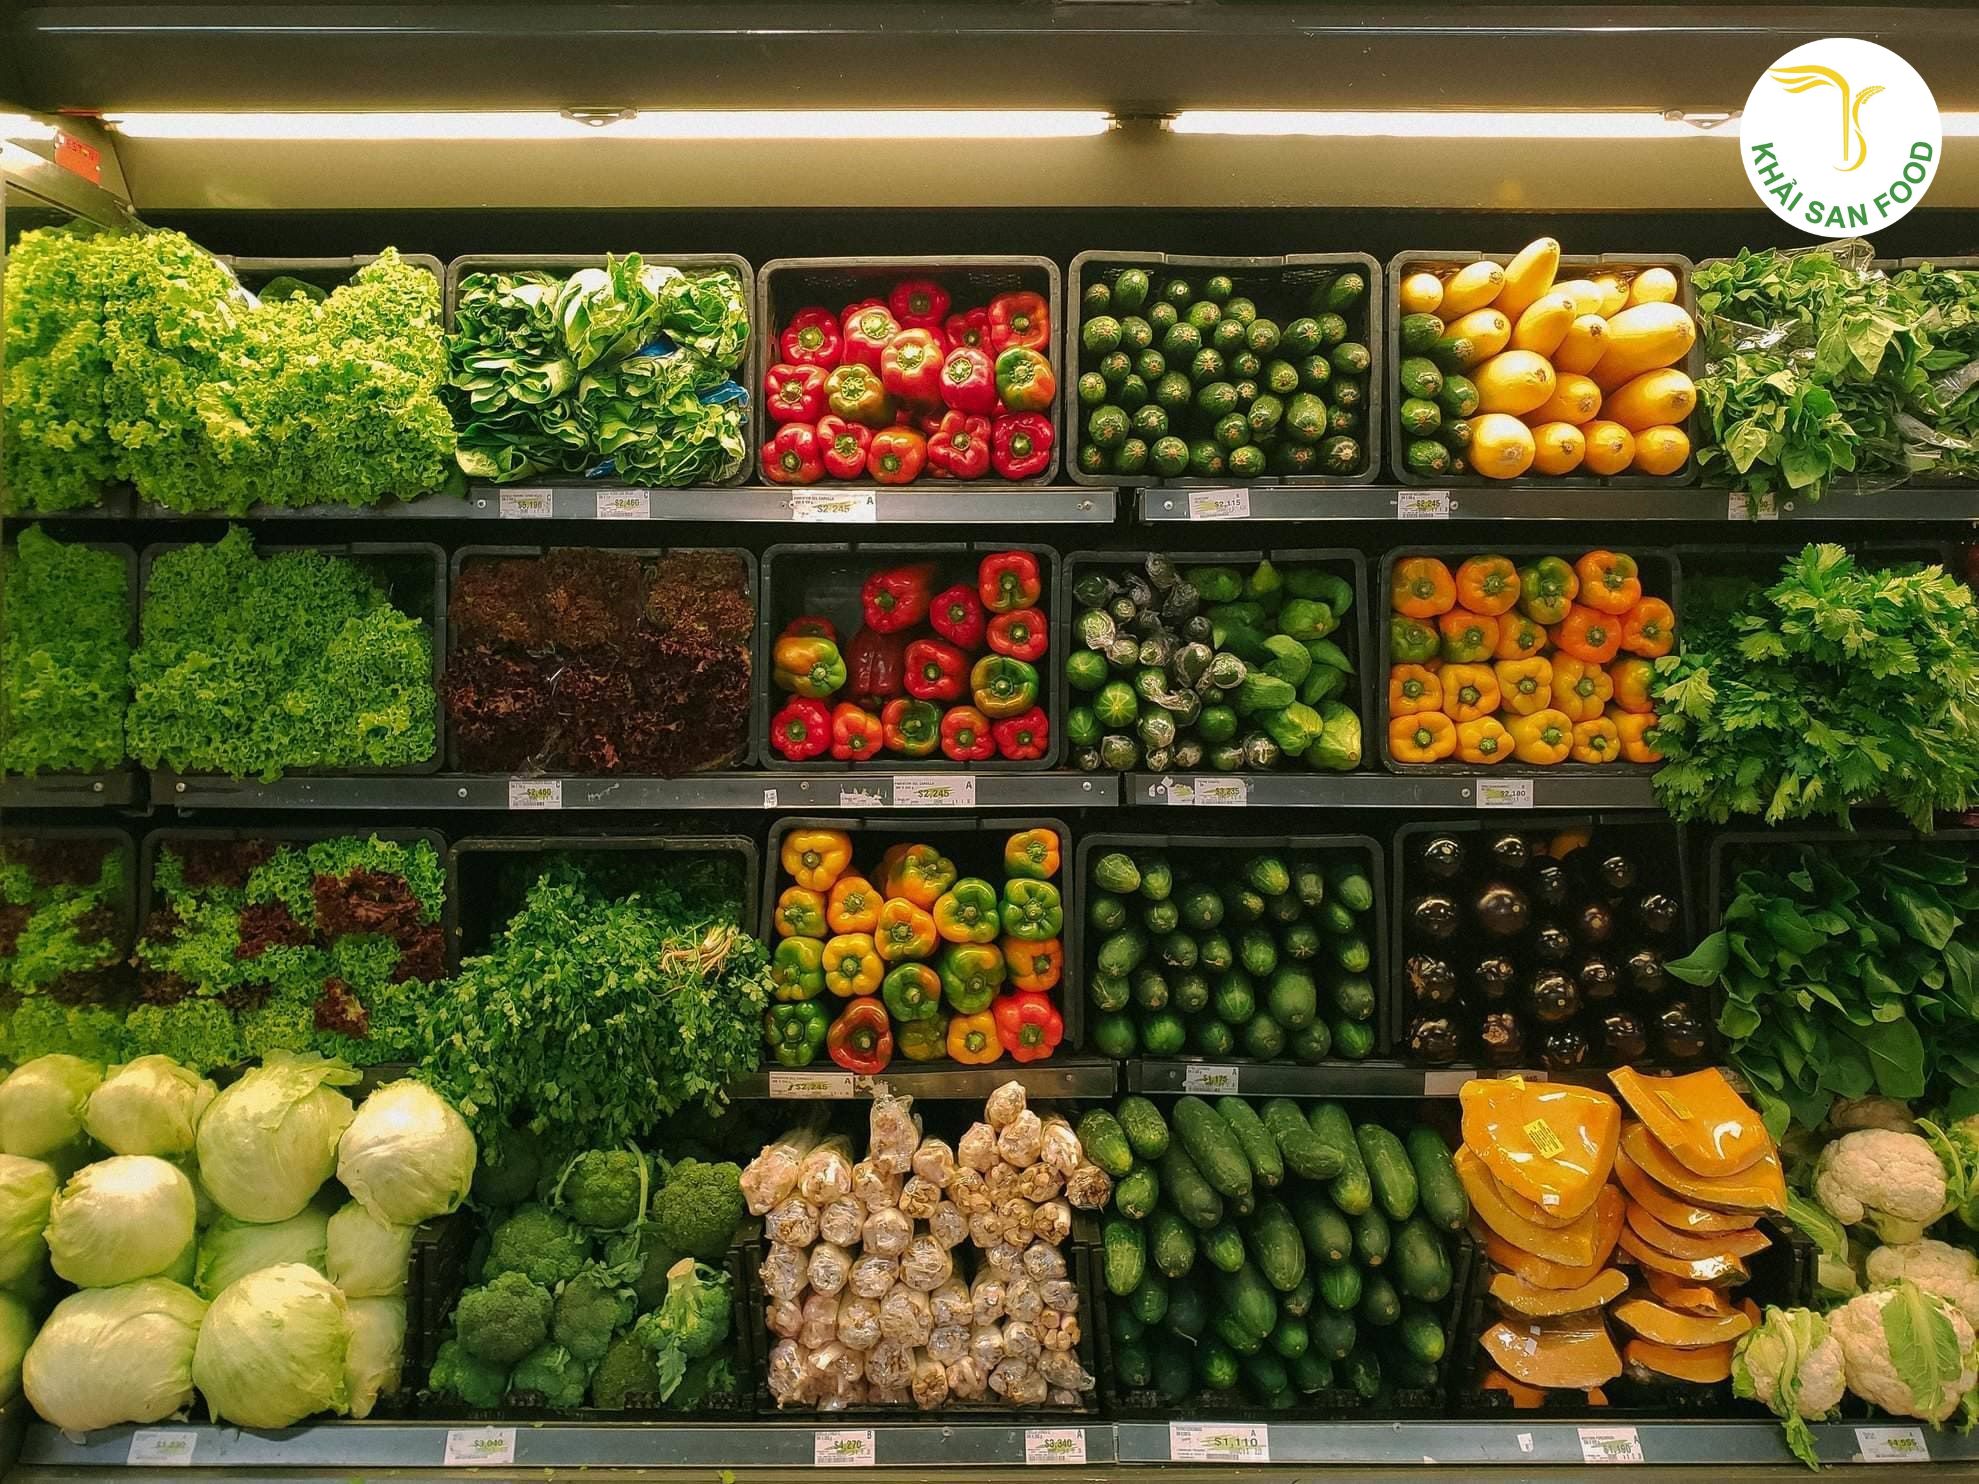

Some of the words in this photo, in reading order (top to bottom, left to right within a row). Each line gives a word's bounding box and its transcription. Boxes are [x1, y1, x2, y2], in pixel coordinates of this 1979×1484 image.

[866, 496, 874, 505] A
[966, 780, 973, 790] A
[1044, 1438, 1073, 1450] $3,340
[1213, 1437, 1258, 1448] $1,110
